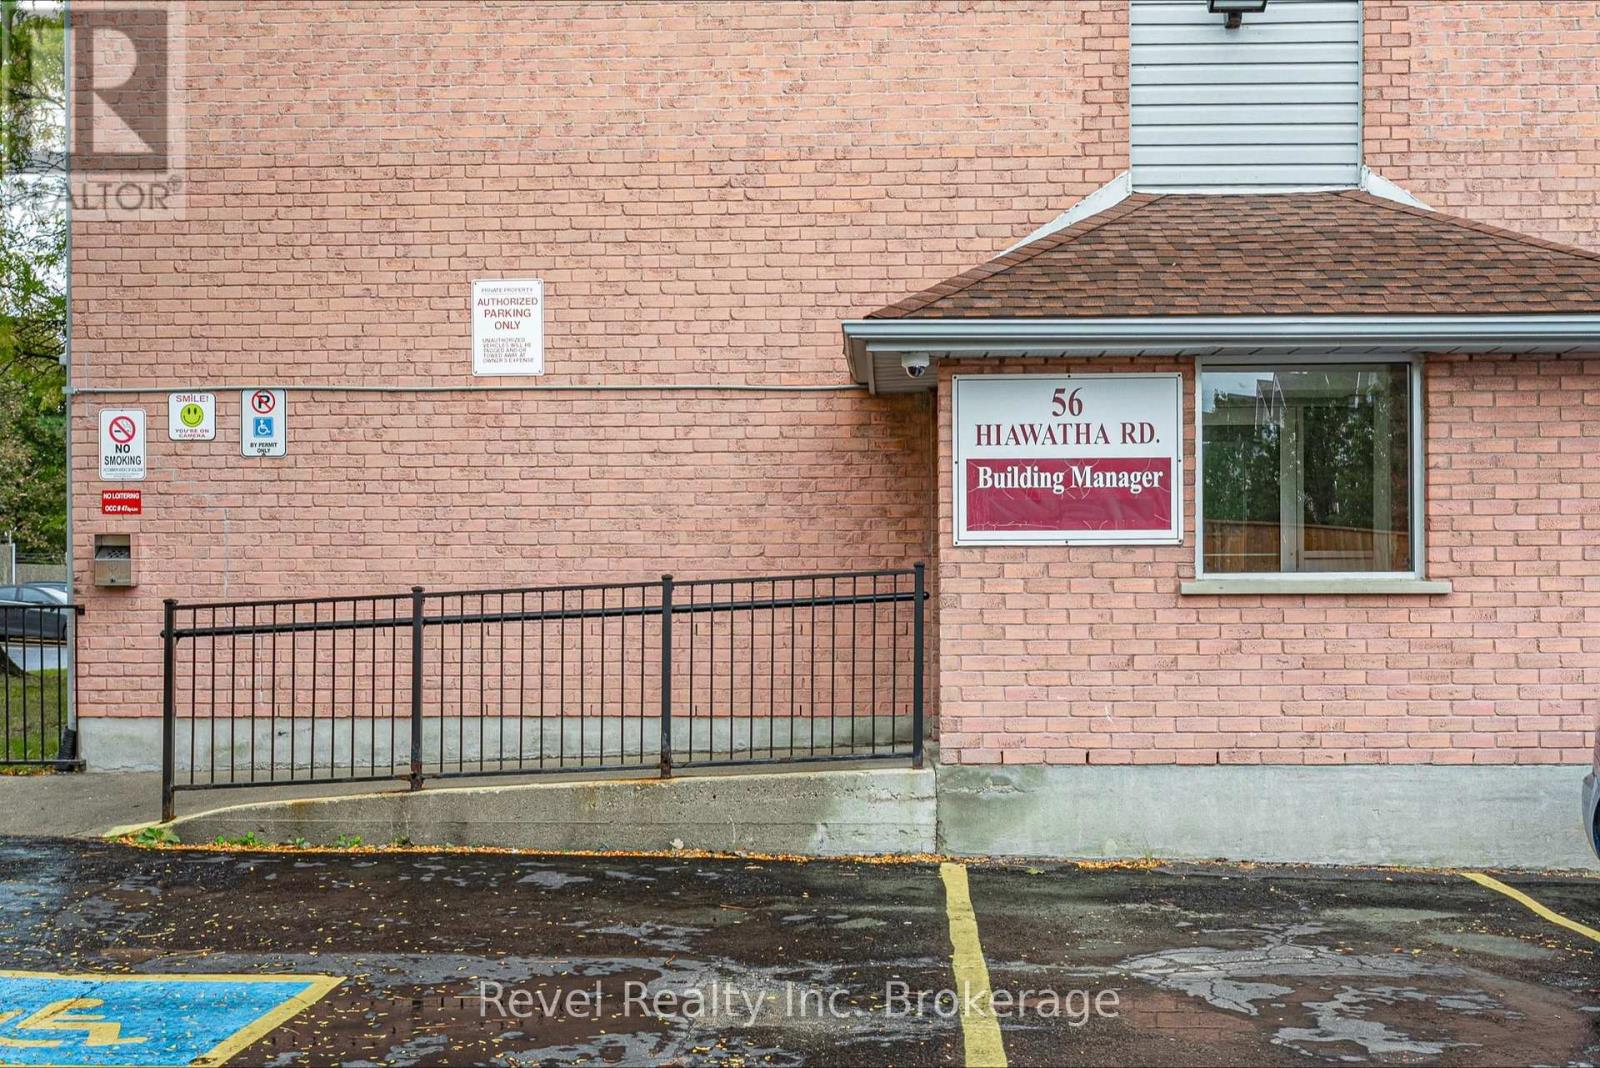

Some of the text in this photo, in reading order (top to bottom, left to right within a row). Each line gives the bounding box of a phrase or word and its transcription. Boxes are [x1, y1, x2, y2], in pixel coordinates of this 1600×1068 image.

[477, 297, 539, 306] AUTHORIZED
[484, 308, 532, 318] PARKING
[494, 320, 521, 330] ONLY
[175, 394, 209, 403] SMILE!
[1051, 387, 1084, 417] 56
[975, 421, 1161, 447] HIAWATHA RD.
[115, 444, 131, 454] NO
[104, 455, 142, 466] SMOKING
[977, 465, 1164, 495] Building Manager
